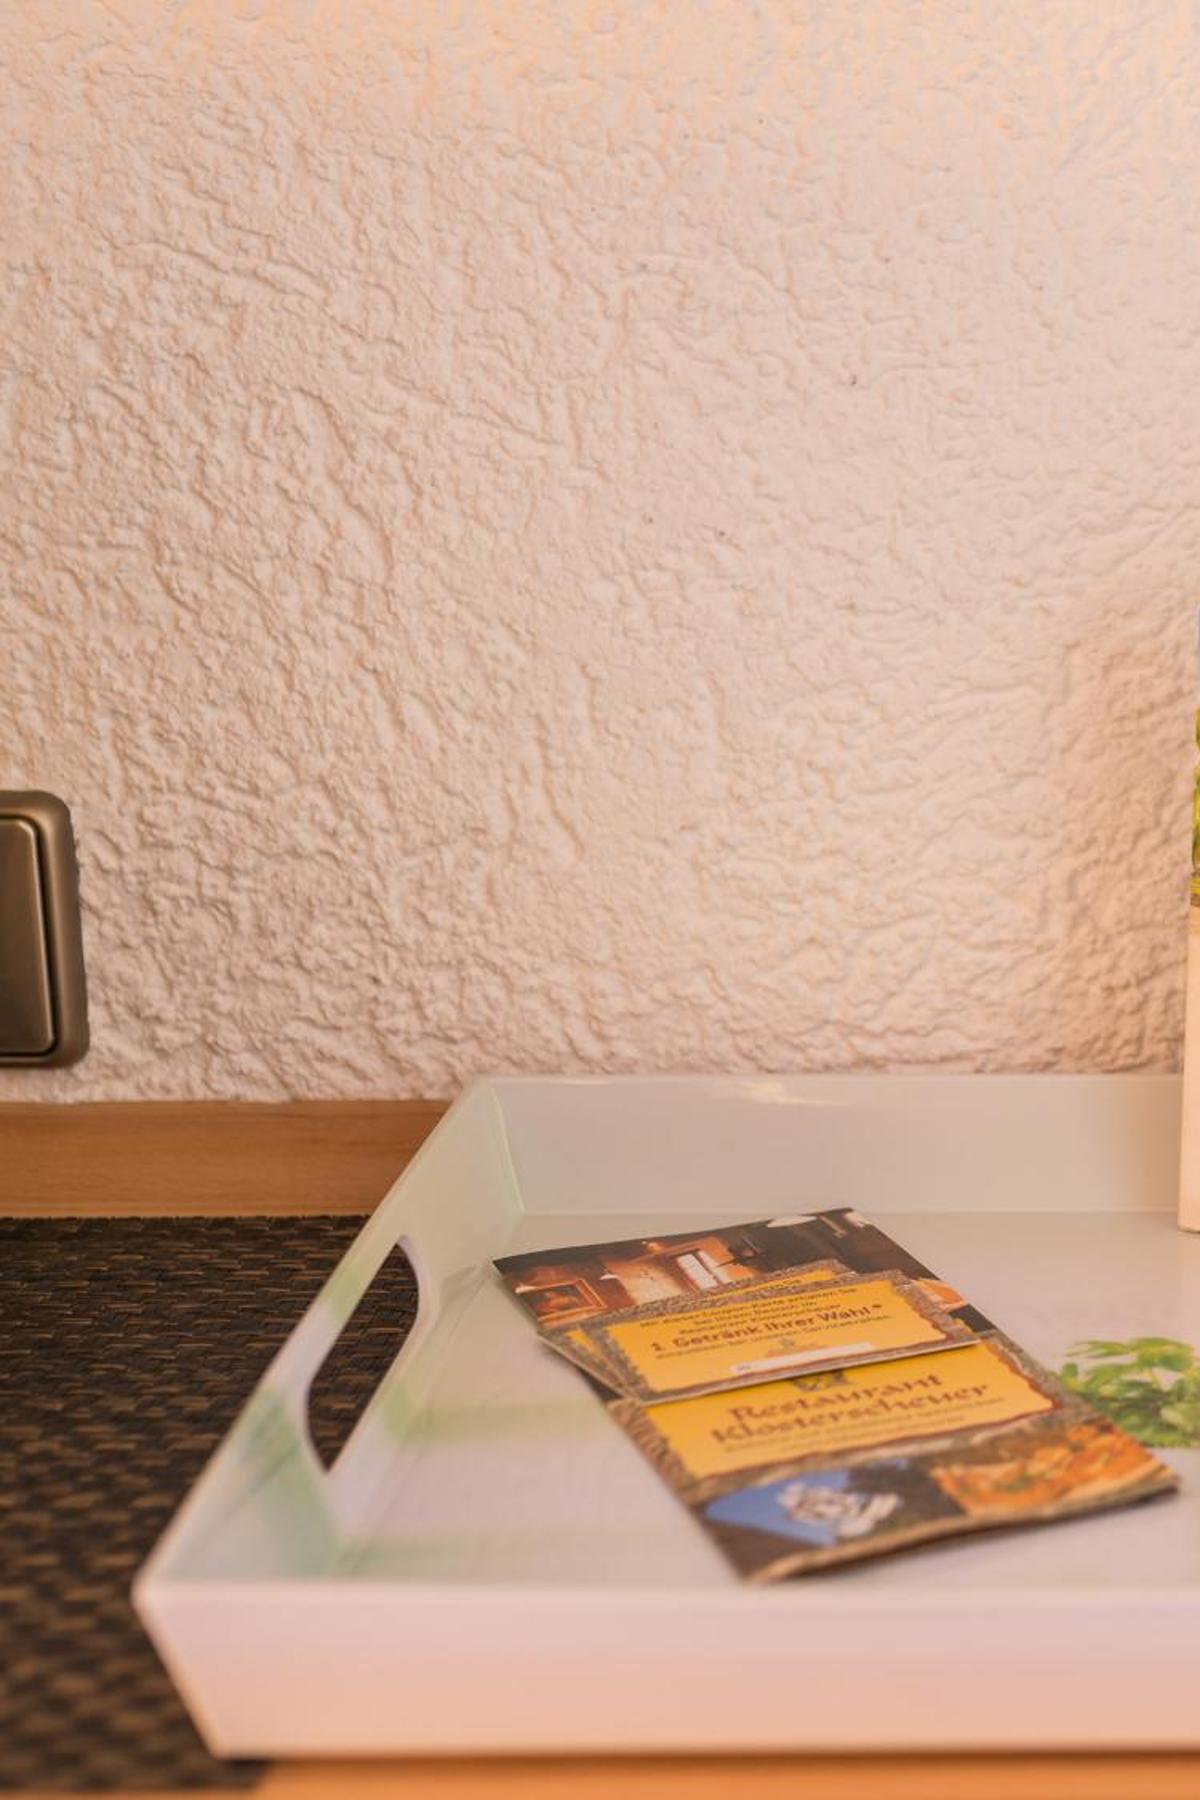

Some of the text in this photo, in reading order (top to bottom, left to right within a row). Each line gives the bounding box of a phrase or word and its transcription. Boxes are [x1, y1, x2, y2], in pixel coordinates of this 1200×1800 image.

[672, 1326, 763, 1348] Getränk
[765, 1317, 815, 1333] Ihrer
[727, 1374, 943, 1422] Restaurant
